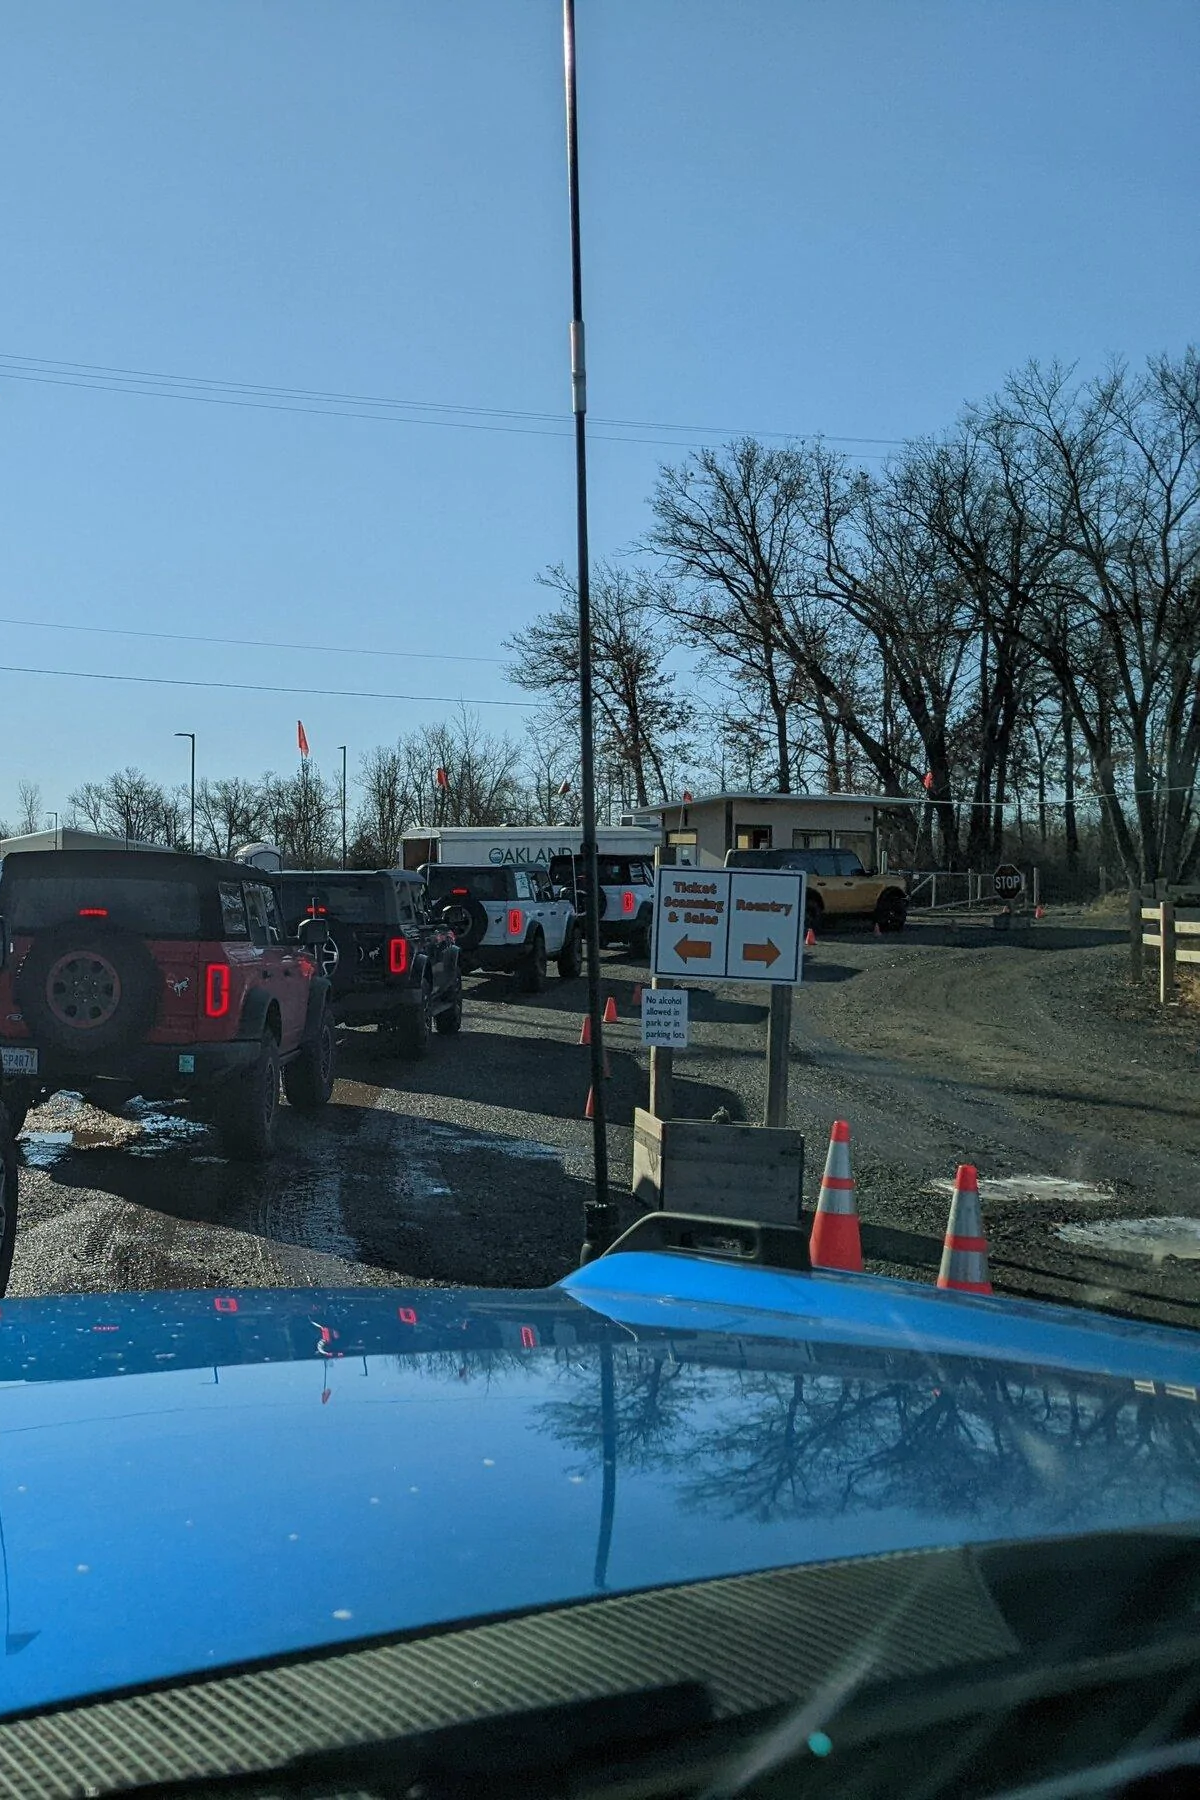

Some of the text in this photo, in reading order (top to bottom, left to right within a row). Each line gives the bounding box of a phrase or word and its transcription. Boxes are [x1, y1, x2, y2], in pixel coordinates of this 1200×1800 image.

[995, 875, 1020, 889] STOP
[673, 881, 717, 895] Ticket
[664, 896, 725, 913] Scanning
[668, 911, 719, 925] & Sales
[646, 996, 682, 1005] No alcohol
[647, 1008, 680, 1016] allowed in
[646, 1020, 661, 1028] park
[646, 1031, 671, 1040] parking
